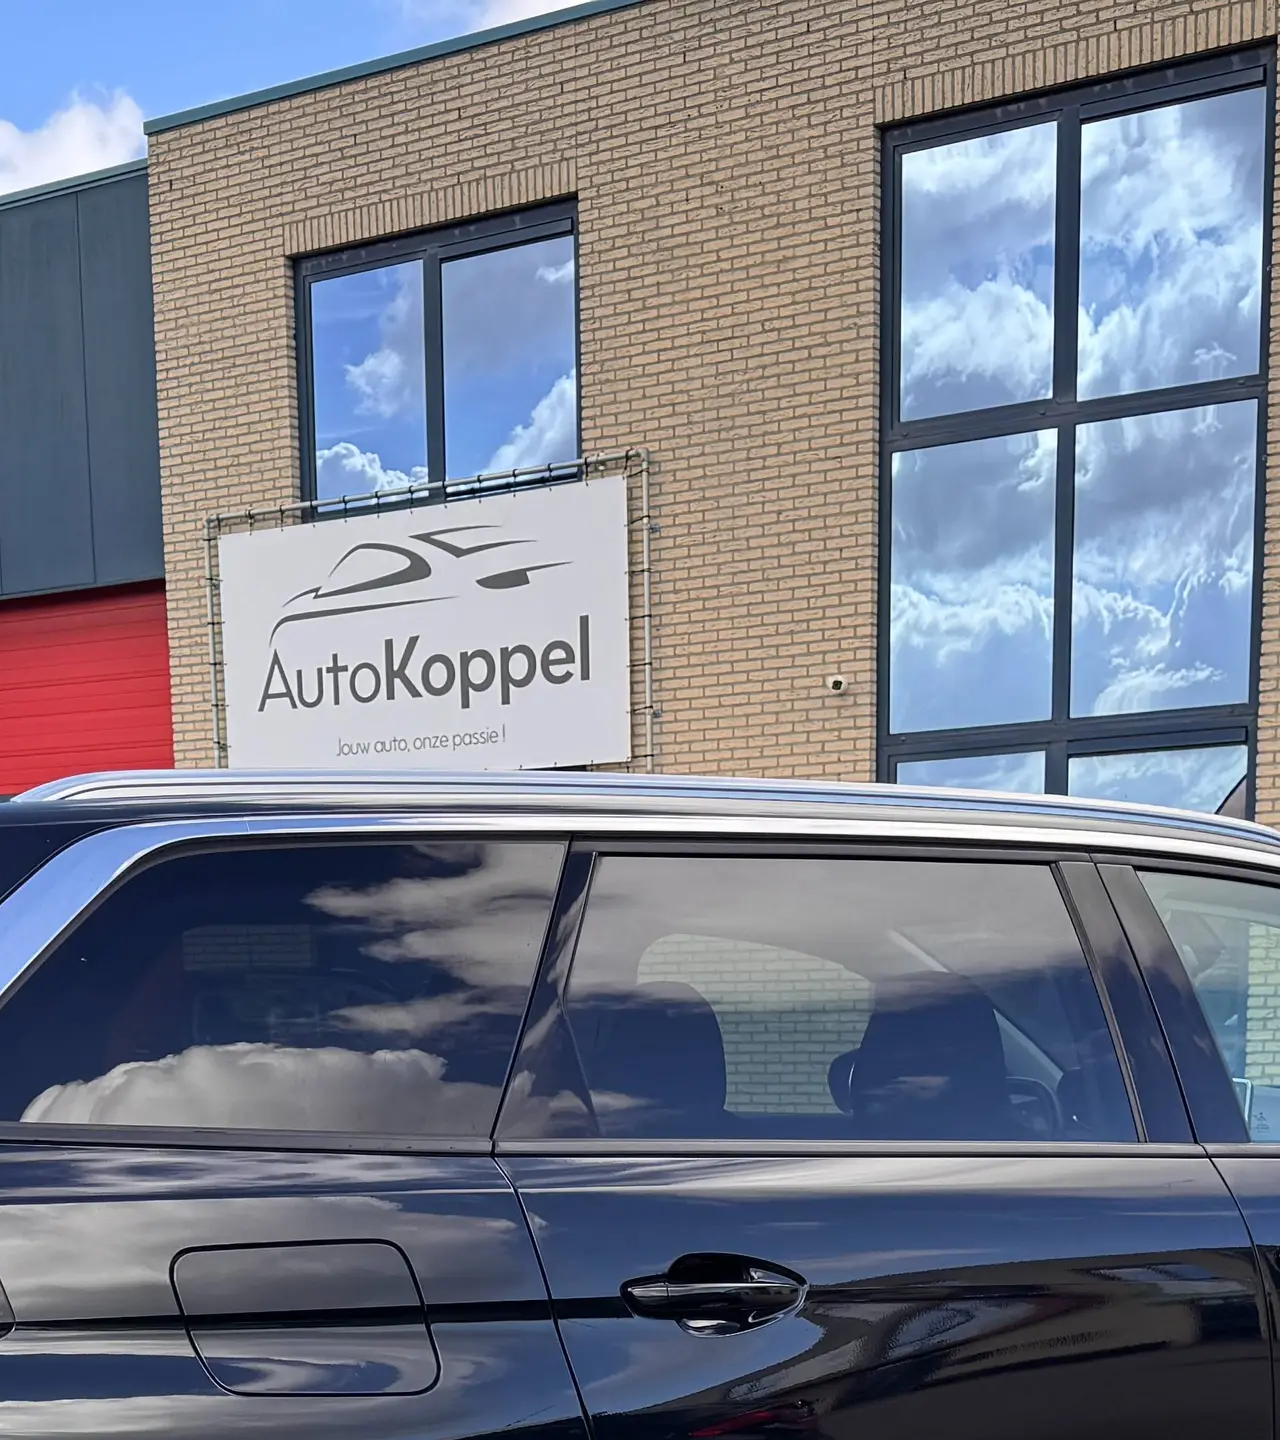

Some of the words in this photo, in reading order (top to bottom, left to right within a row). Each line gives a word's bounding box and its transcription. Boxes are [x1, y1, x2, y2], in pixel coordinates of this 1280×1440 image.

[258, 614, 590, 712] AutoKoppel
[336, 738, 370, 757] Jouw
[374, 736, 411, 753] auto,
[413, 734, 449, 750] onze
